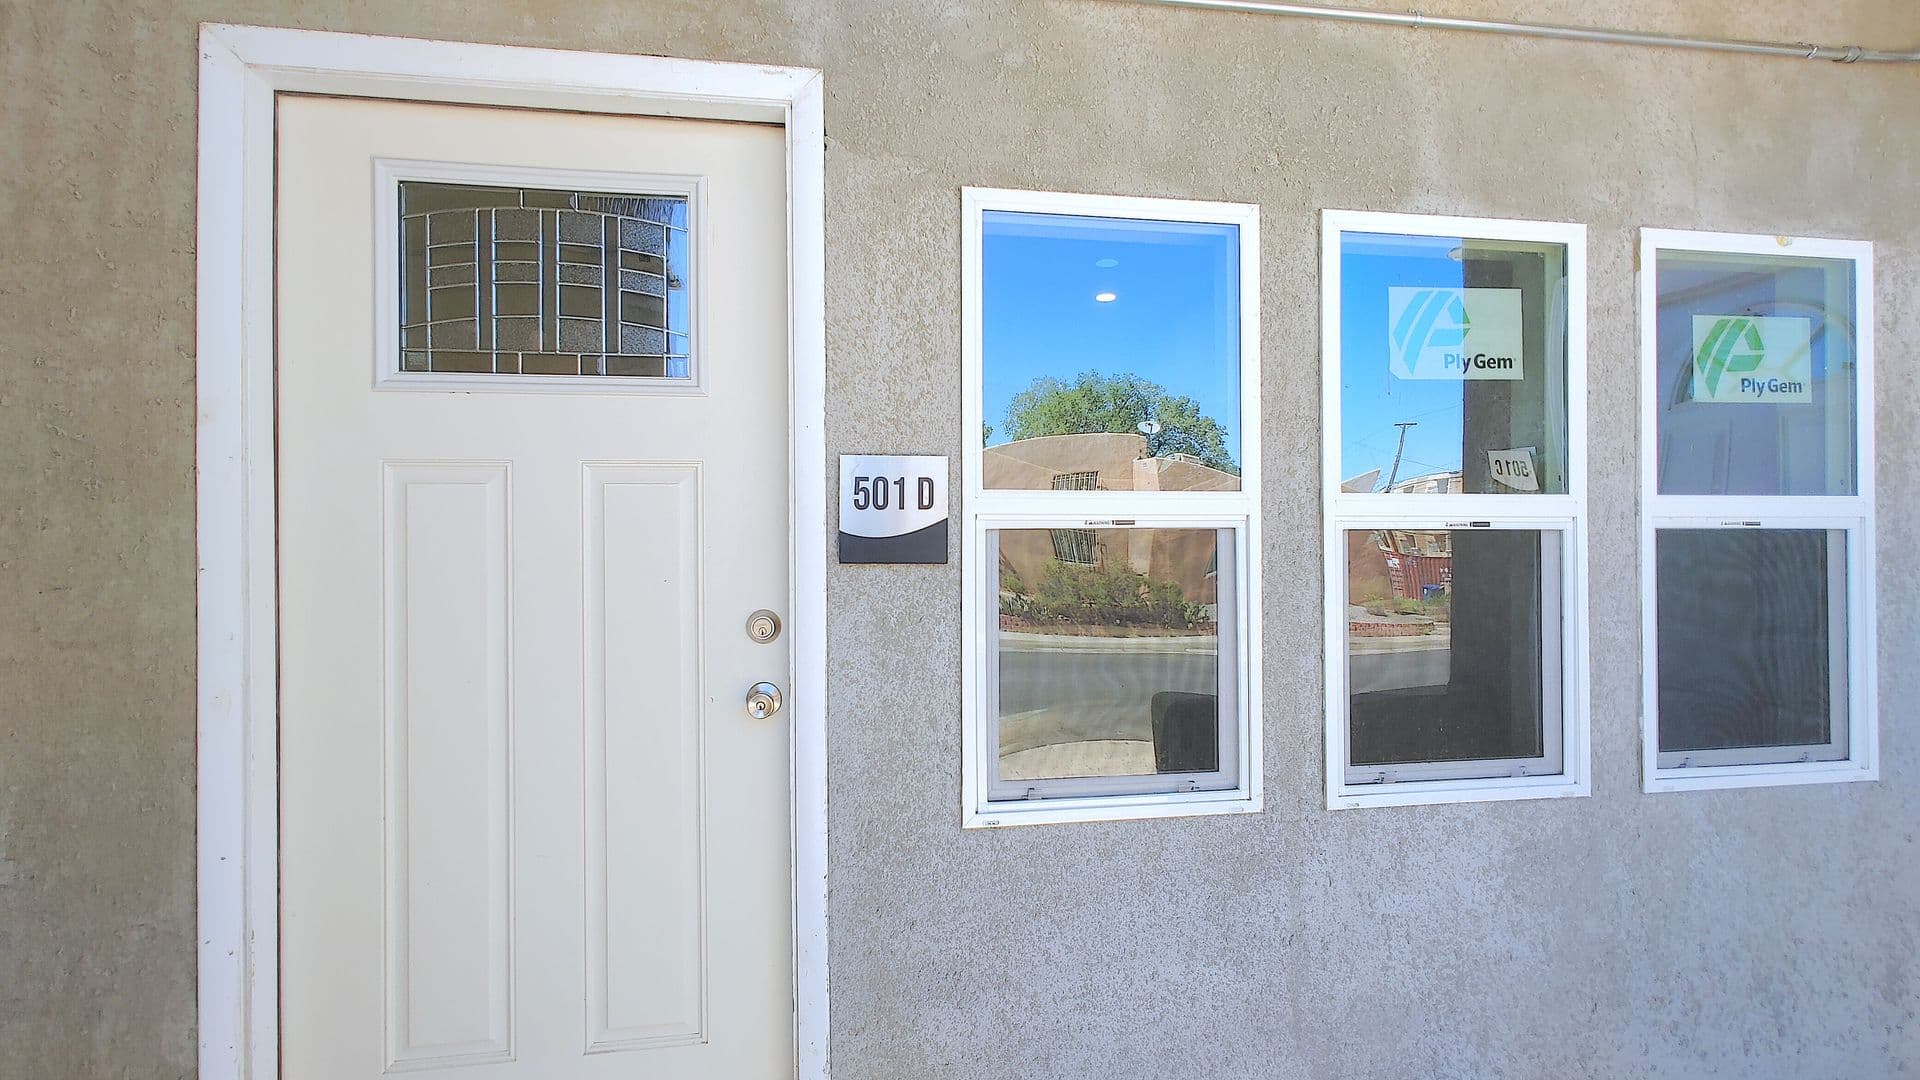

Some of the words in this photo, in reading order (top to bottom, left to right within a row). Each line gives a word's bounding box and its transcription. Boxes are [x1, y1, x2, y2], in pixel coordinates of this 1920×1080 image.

[1444, 353, 1471, 374] Ply
[1474, 353, 1513, 369] Gem
[1740, 377, 1765, 397] Ply
[1768, 378, 1803, 393] Gem
[853, 476, 905, 511] 501
[917, 476, 934, 510] D
